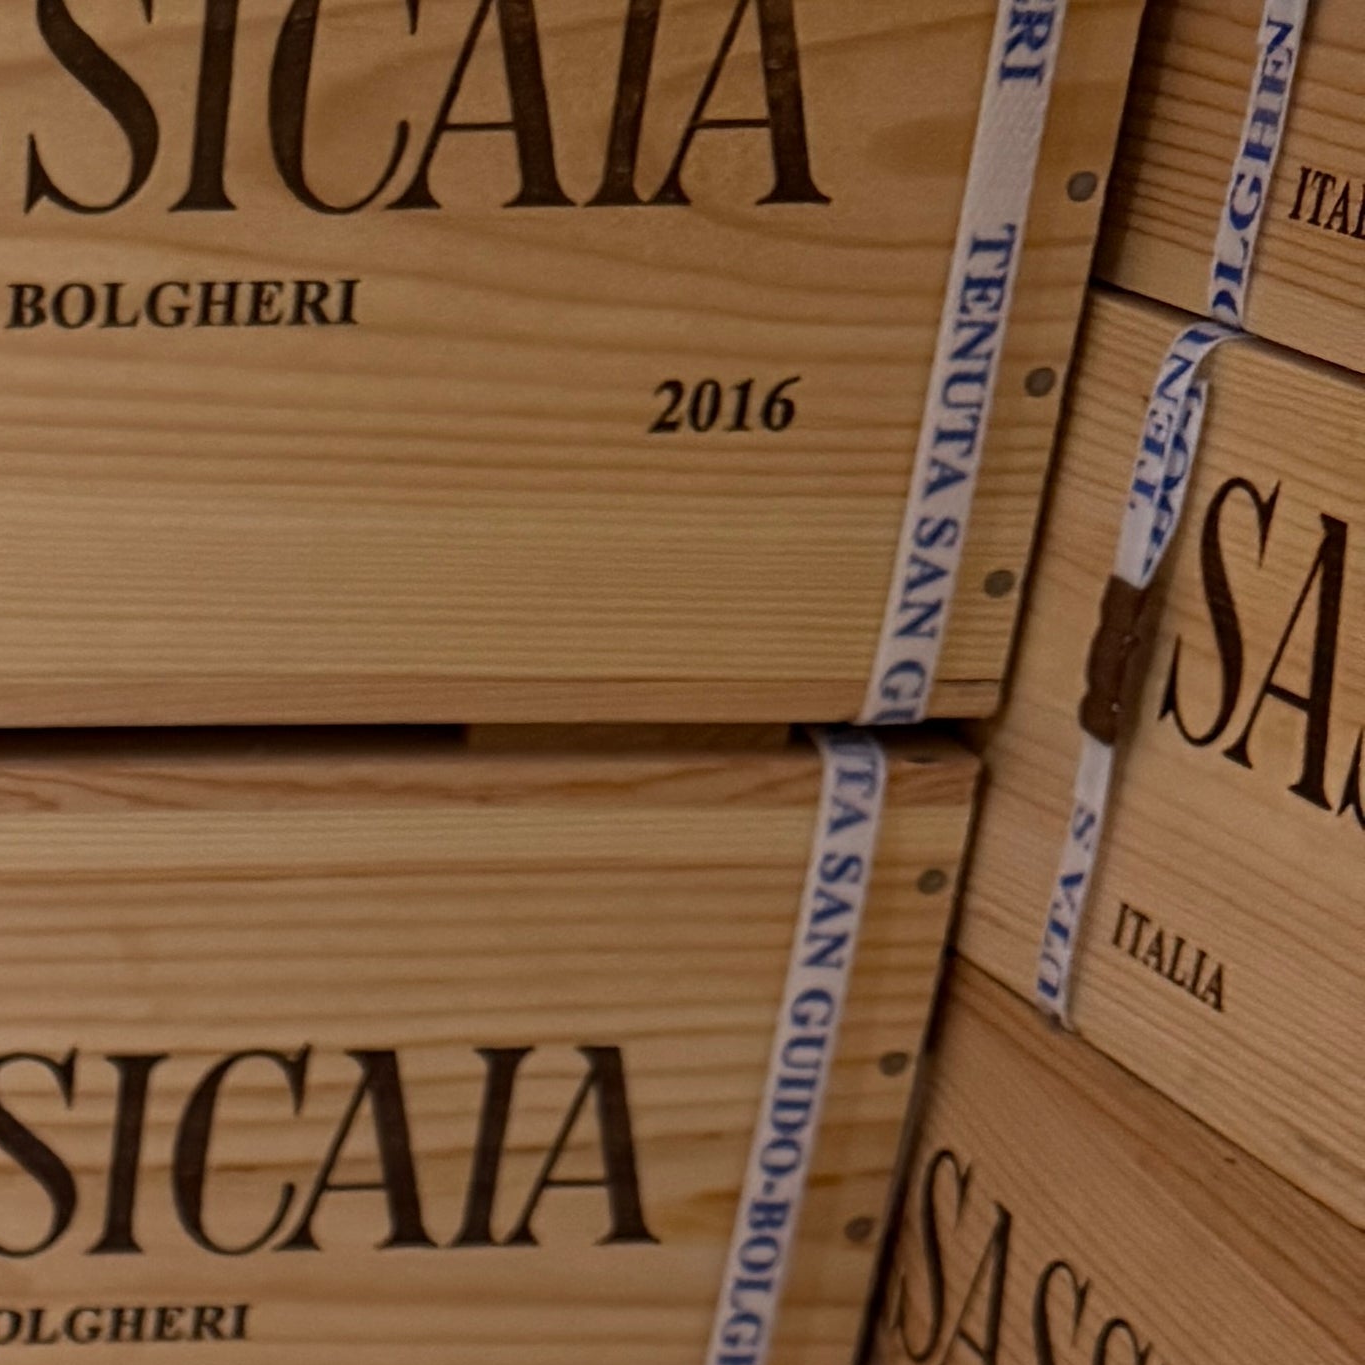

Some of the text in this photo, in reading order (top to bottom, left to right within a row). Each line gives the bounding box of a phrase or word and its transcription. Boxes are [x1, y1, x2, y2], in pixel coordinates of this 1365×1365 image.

[6, 278, 361, 329] BOLGHERI
[648, 376, 803, 434] 2016
[926, 225, 1017, 498] TENUTA
[894, 515, 960, 640] SAN
[802, 852, 864, 971] SAN
[1111, 902, 1227, 1014] ITALIA
